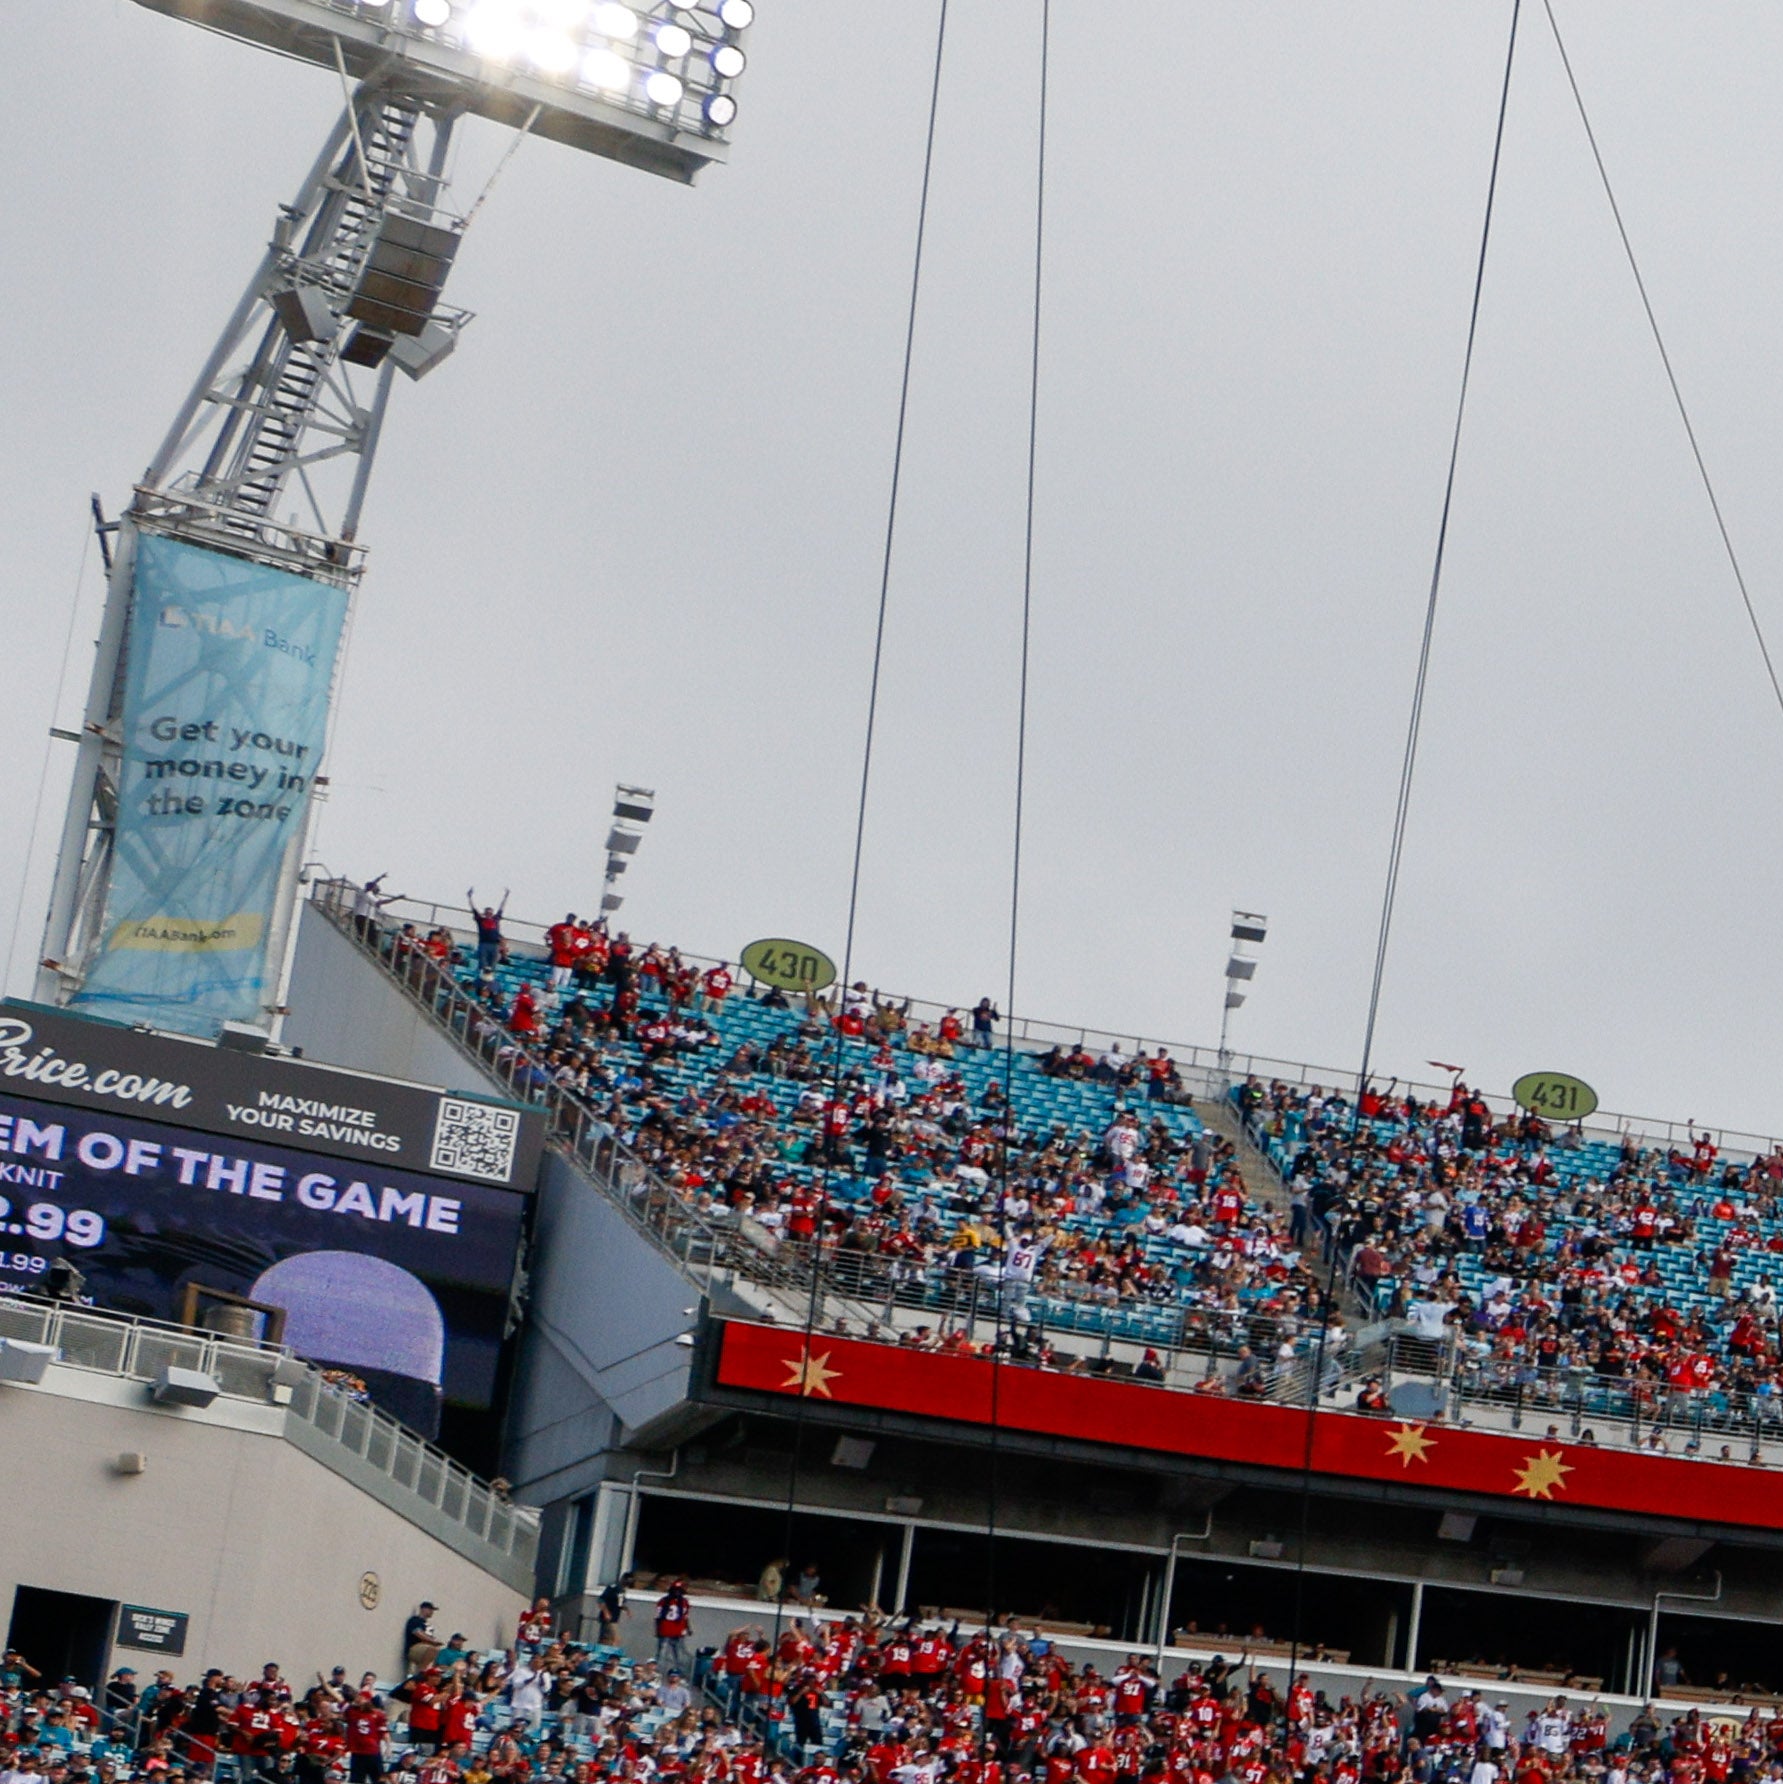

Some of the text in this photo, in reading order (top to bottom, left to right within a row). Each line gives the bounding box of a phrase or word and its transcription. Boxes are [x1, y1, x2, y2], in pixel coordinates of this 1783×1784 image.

[263, 628, 316, 667] Bank
[152, 716, 308, 760] Get your
[145, 759, 304, 792] money in
[148, 787, 291, 821] the zone
[759, 952, 818, 982] 430
[259, 1091, 376, 1128] MAXIMIZE
[1531, 1080, 1579, 1110] 431
[227, 1104, 401, 1152] YOUR SAVINGS
[78, 1132, 162, 1175] OF
[172, 1147, 286, 1201] THE
[297, 1172, 462, 1235] GAME
[893, 1648, 908, 1662] 19
[1713, 1723, 1737, 1738] 21
[1245, 1770, 1261, 1782] 97
